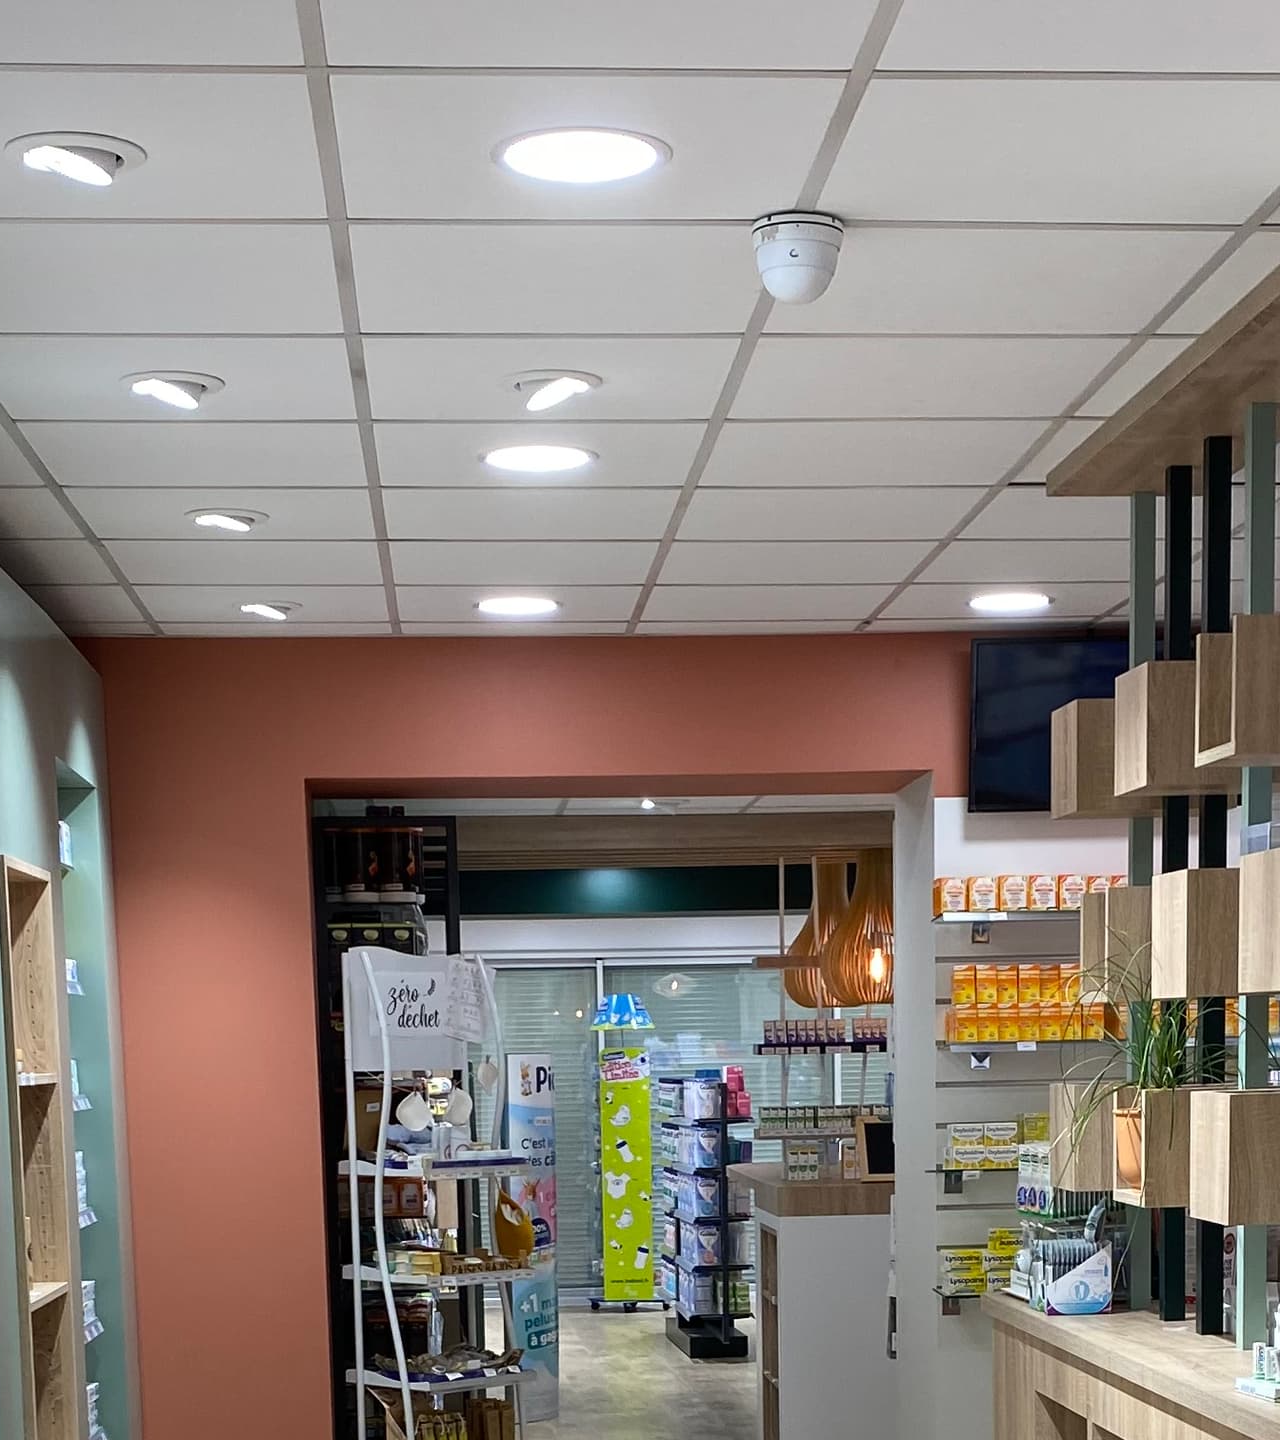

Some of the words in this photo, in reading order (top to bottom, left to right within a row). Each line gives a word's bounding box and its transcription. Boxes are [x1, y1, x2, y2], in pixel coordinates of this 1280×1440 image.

[386, 979, 419, 1015] zéro
[397, 1003, 440, 1028] déchet
[520, 1293, 539, 1314] +1
